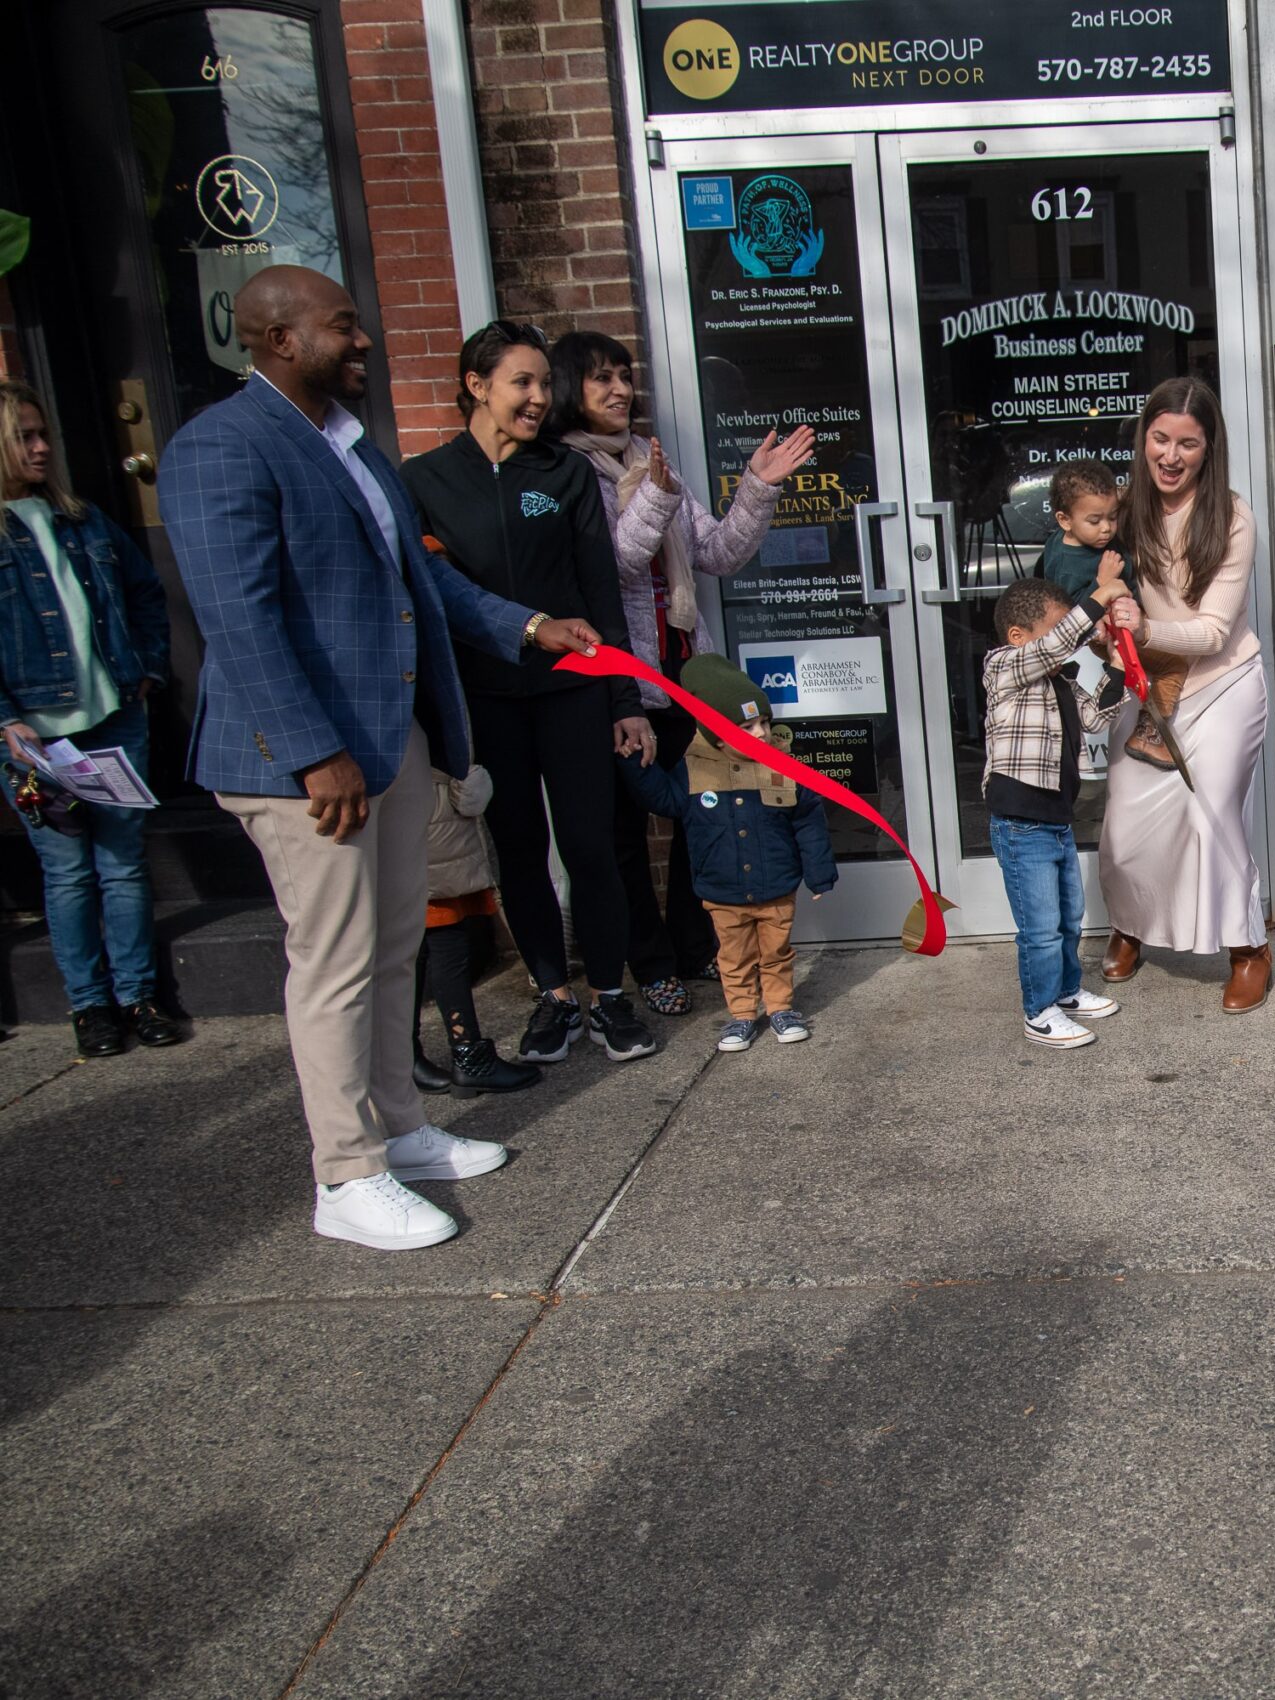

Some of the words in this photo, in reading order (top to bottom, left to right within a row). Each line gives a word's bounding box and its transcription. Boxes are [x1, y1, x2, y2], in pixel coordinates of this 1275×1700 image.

[1071, 11, 1104, 28] 2nd
[1110, 9, 1173, 26] FLOOR
[671, 48, 732, 72] ONE
[749, 38, 984, 69] REALTYONEGROUP
[201, 54, 239, 81] 616
[1037, 54, 1212, 82] 570-787-2435
[852, 70, 909, 88] NEXT
[919, 67, 985, 86] DOOR
[696, 183, 719, 194] PROUD
[770, 179, 809, 214] WELLNESS
[693, 194, 725, 206] PARTNER
[1031, 187, 1094, 221] 612
[221, 243, 239, 256] EST
[242, 241, 269, 255] 2015
[751, 288, 760, 298] S.
[832, 284, 842, 295] D.
[739, 303, 771, 312] Licensed
[772, 301, 817, 311] Psychologist
[705, 319, 758, 330] Psychological
[759, 317, 792, 327] Services
[793, 316, 808, 325] and
[809, 315, 854, 324] Evaluations
[941, 292, 1048, 347] DOMINICK
[1052, 291, 1071, 319] A.
[1074, 290, 1196, 334] LOCKWOOD
[993, 333, 1077, 358] Business
[1080, 330, 1144, 355] Center
[1014, 376, 1060, 394] MAIN
[1064, 372, 1130, 391] STREET
[991, 396, 1092, 418] COUNSELING
[1095, 394, 1151, 413] CENTE
[716, 410, 780, 430] Newberry
[782, 408, 820, 424] Office
[822, 406, 861, 422] Suites
[717, 438, 734, 447] J.H.
[817, 432, 841, 442] CPA'S
[1028, 449, 1052, 463] Dr.
[1055, 448, 1097, 462] Kelly
[721, 461, 737, 470] Paul
[738, 461, 744, 469] J.
[717, 473, 844, 497] PTER
[520, 496, 560, 513] FitPlay
[769, 516, 803, 527] ngineers
[805, 514, 812, 522] &
[815, 511, 835, 522] Land
[733, 580, 757, 589] Eileen
[758, 577, 811, 588] Brito-Canellas
[812, 575, 840, 586] Garcia,
[735, 613, 755, 624] King,
[757, 612, 777, 623] Spry,
[777, 610, 809, 620] Herman,
[810, 607, 837, 618] Freund
[838, 608, 844, 616] &
[738, 630, 762, 639] Stellar
[763, 628, 805, 639] Technology
[806, 626, 841, 636] Solutions
[842, 625, 855, 635] LLC
[801, 661, 861, 671] ABRAHAMSEN
[761, 672, 797, 689] ACA
[802, 677, 863, 687] ABRAHAMSEN
[795, 729, 868, 739] REALTYONEGROUP
[816, 752, 854, 763] Estate
[814, 768, 852, 779] erage
